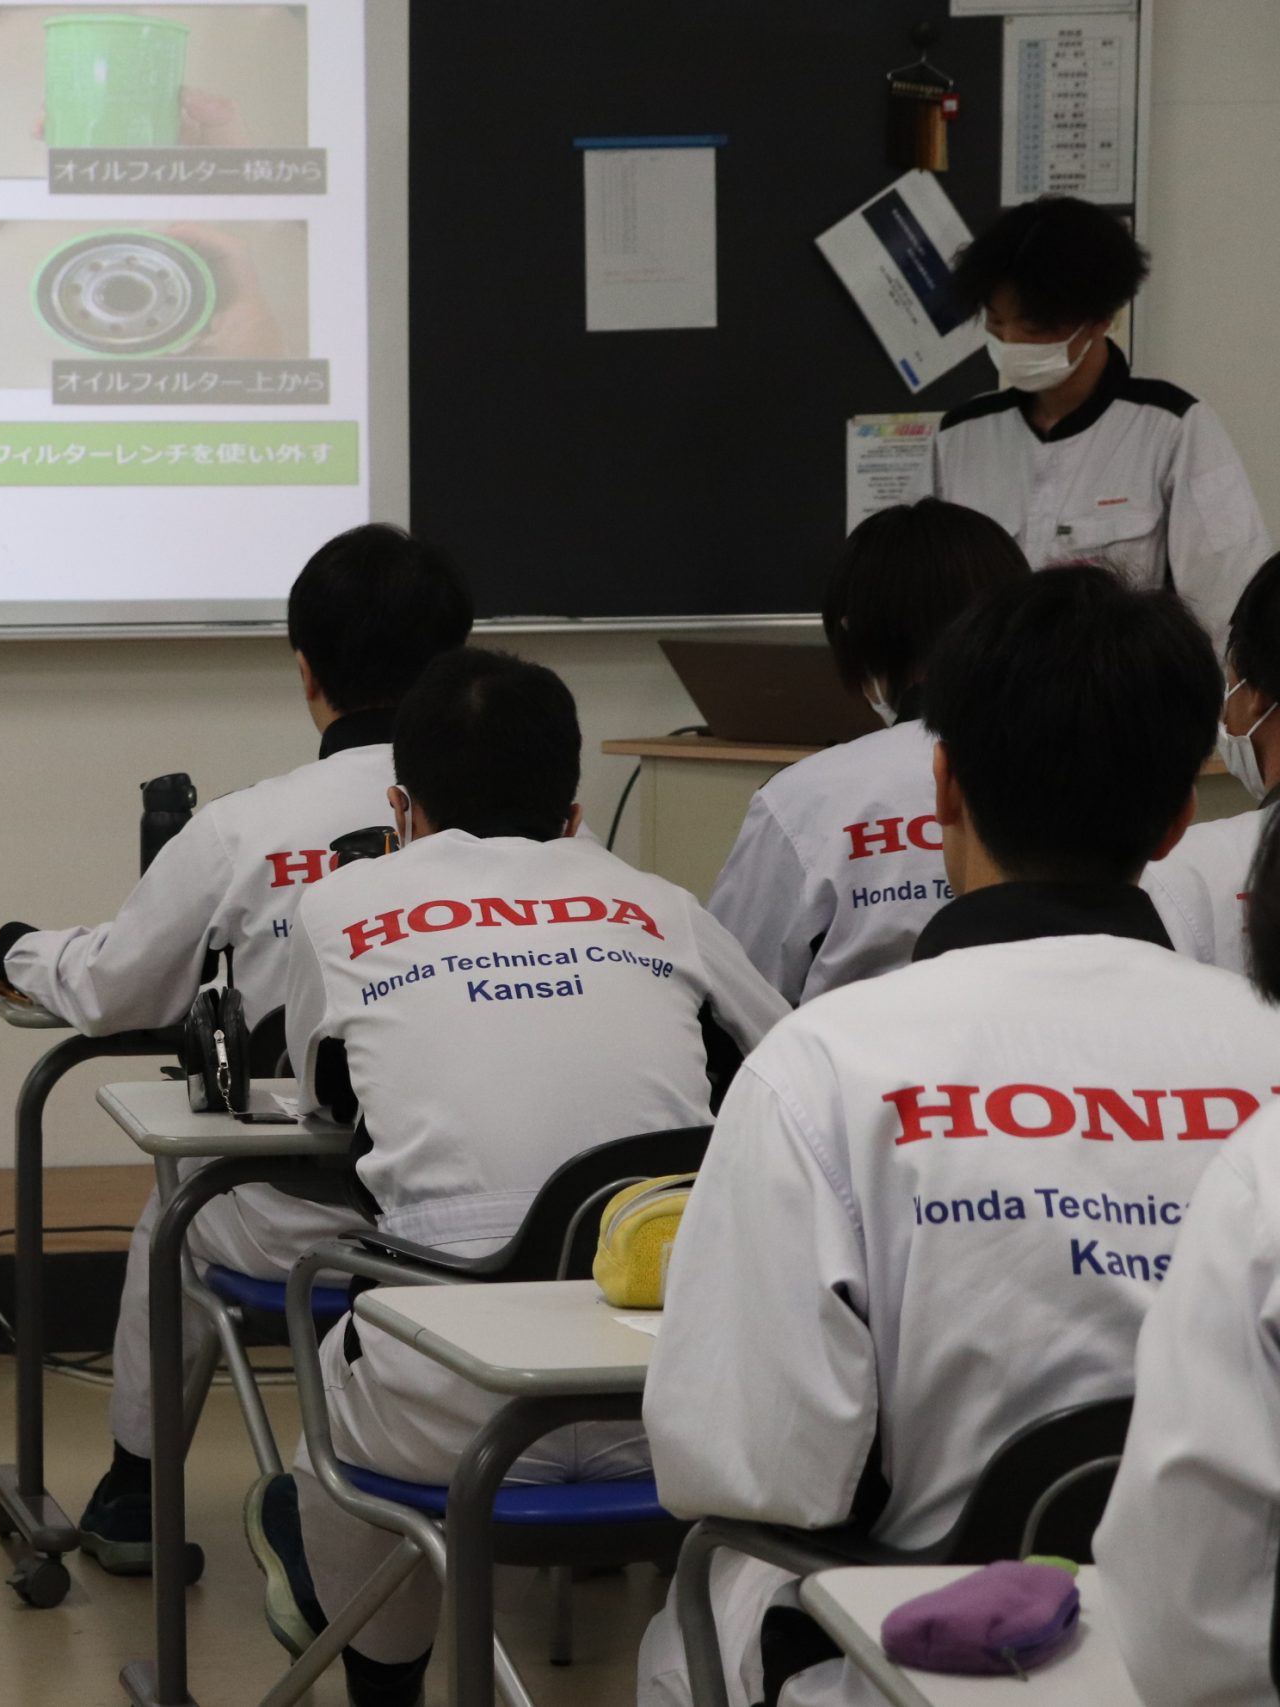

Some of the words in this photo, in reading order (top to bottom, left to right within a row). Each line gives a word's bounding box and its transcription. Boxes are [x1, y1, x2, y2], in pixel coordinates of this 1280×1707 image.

[55, 159, 322, 182] オイルフィルター横から
[57, 371, 326, 393] オイルフィルター上から
[851, 880, 927, 909] Honda
[341, 895, 666, 961] HONDA
[361, 964, 436, 1006] Honda
[441, 947, 579, 971] Technical
[585, 946, 674, 979] College
[467, 975, 585, 1002] Kansai
[881, 1082, 1280, 1147] HOND
[1034, 1188, 1190, 1226] Technic
[1070, 1238, 1172, 1282] Kans
